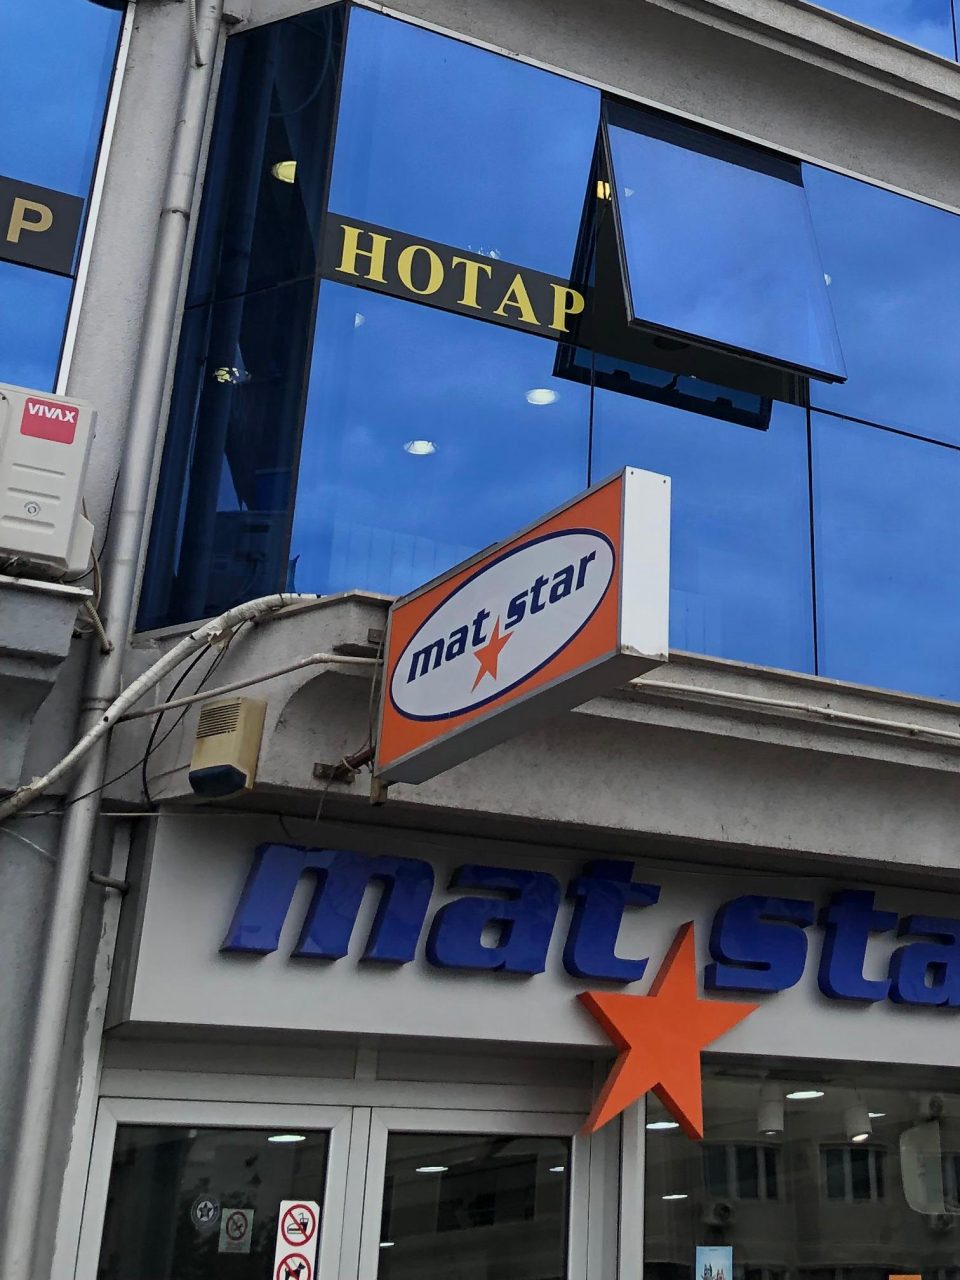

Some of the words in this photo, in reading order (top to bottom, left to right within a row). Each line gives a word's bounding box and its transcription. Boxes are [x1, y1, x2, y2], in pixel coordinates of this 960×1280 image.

[335, 224, 586, 333] НОТАР
[28, 402, 76, 424] VIVAX
[406, 608, 492, 684] mat
[504, 550, 597, 631] star
[218, 842, 661, 984] mat
